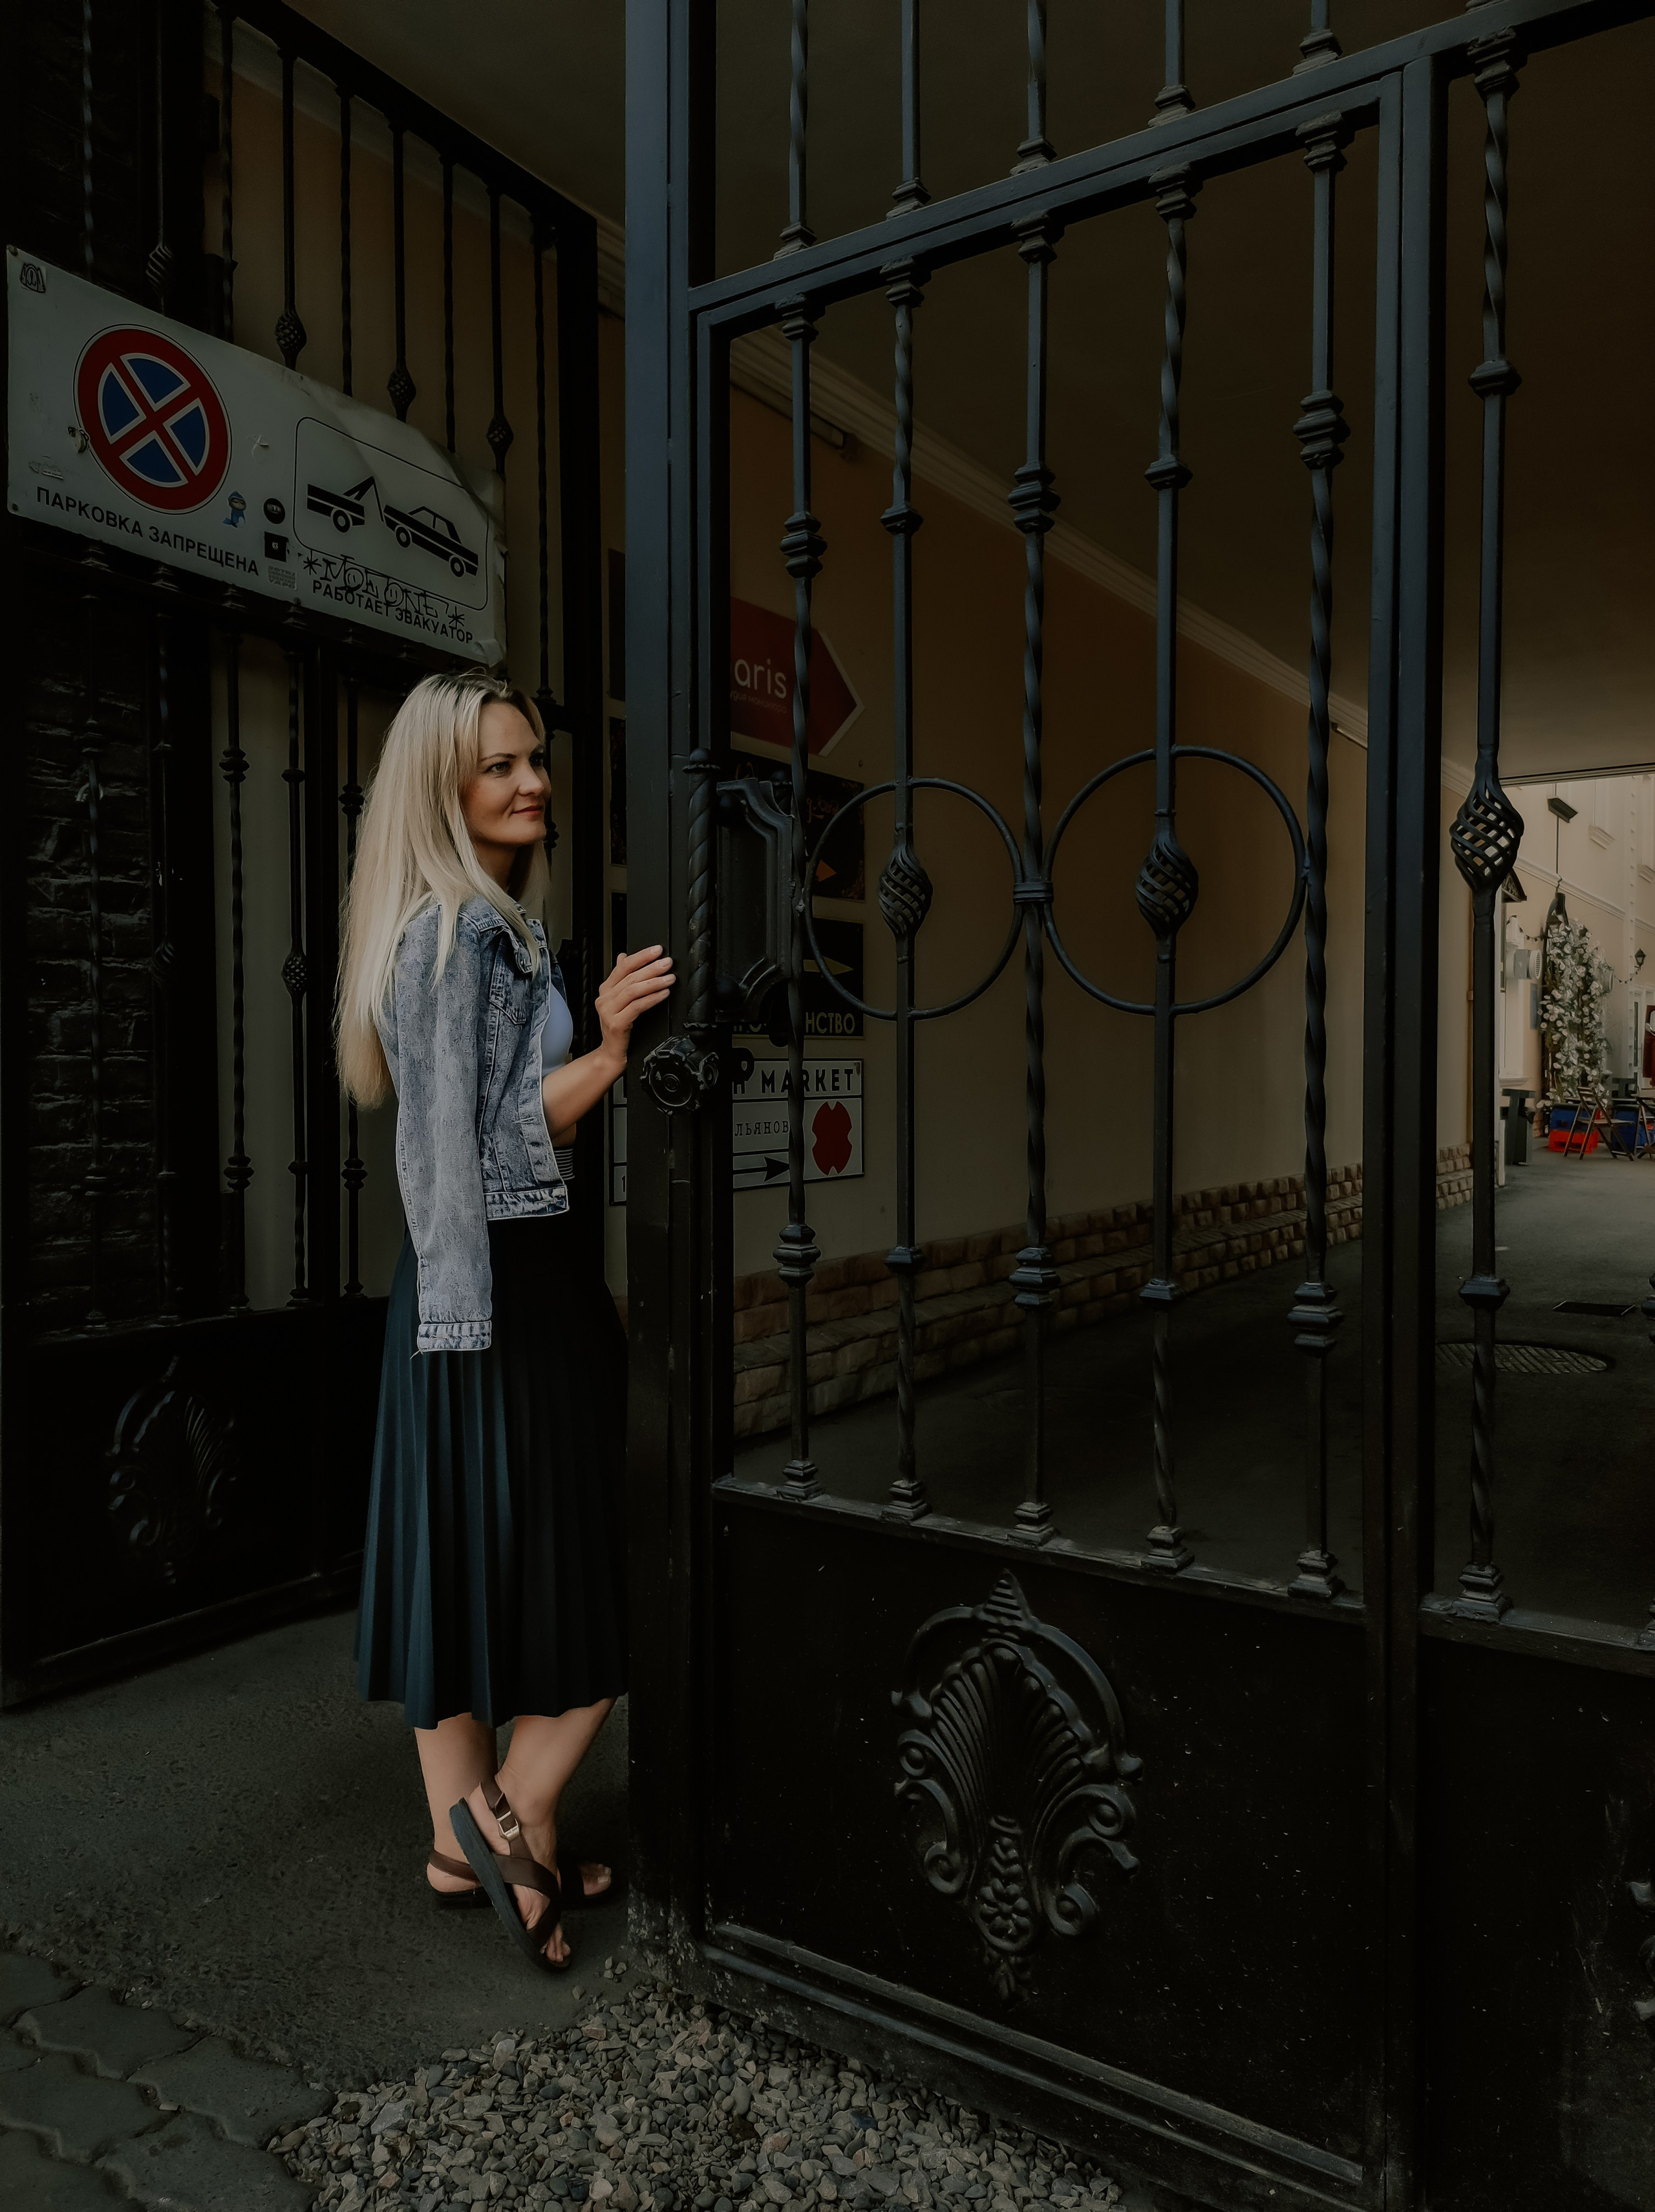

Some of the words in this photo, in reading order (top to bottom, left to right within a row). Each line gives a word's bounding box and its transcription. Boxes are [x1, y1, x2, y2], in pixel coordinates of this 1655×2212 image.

[37, 486, 142, 537] ПАРКОВКА
[149, 525, 259, 575] ЗАПРЕЩЕНА
[313, 579, 390, 617] РАБОТАЕТ
[395, 608, 474, 643] ЭВАКУАТОР
[734, 658, 787, 699] aris
